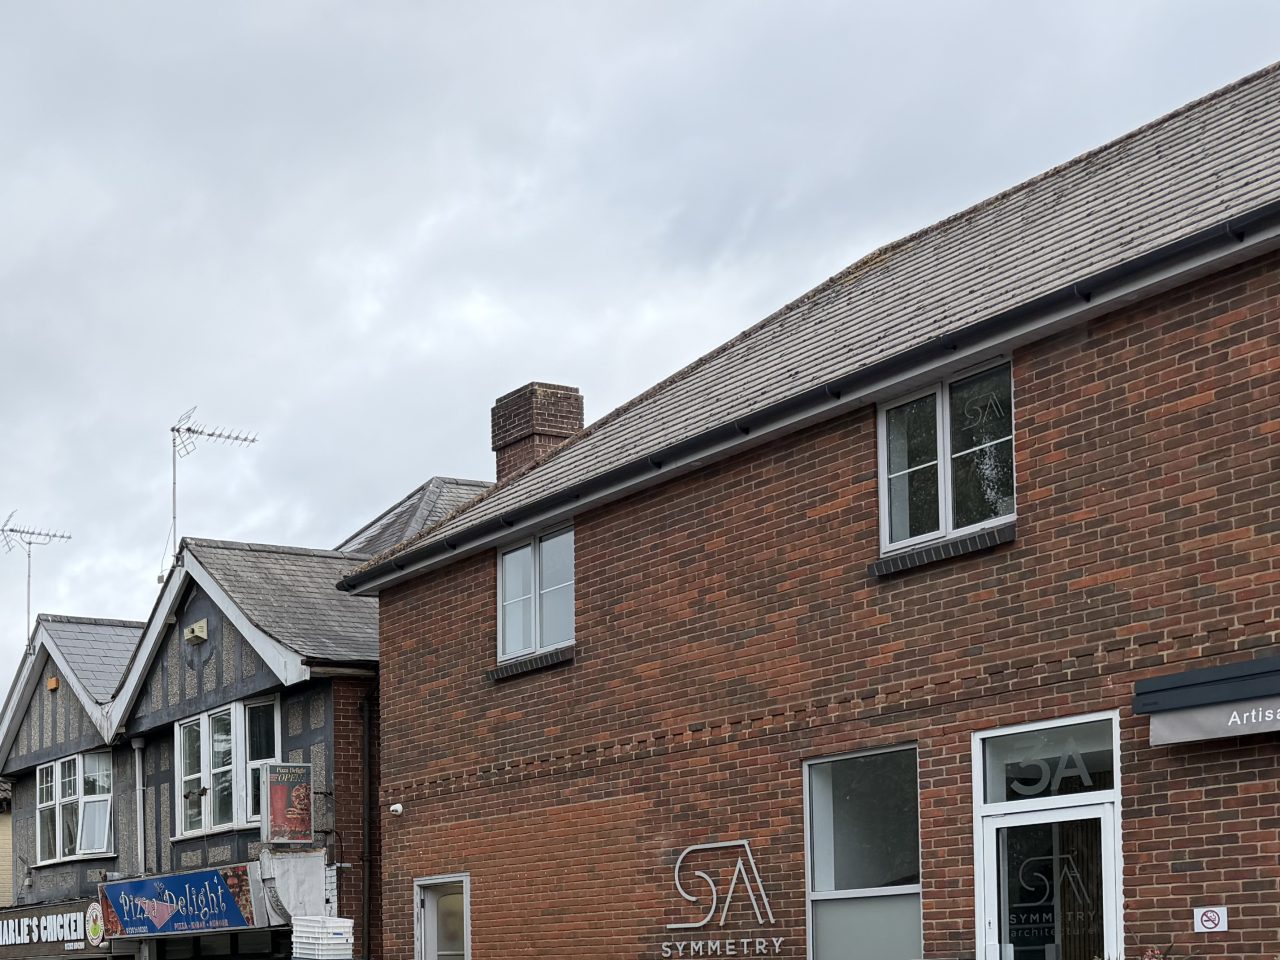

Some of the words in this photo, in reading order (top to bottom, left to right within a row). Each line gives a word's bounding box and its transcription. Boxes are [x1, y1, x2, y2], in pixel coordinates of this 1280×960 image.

[1009, 735, 1093, 796] 3A
[119, 890, 157, 921] Pizza
[164, 880, 227, 921] Delight
[40, 911, 85, 943] CHICKEN
[661, 937, 785, 958] SYMMETRY
